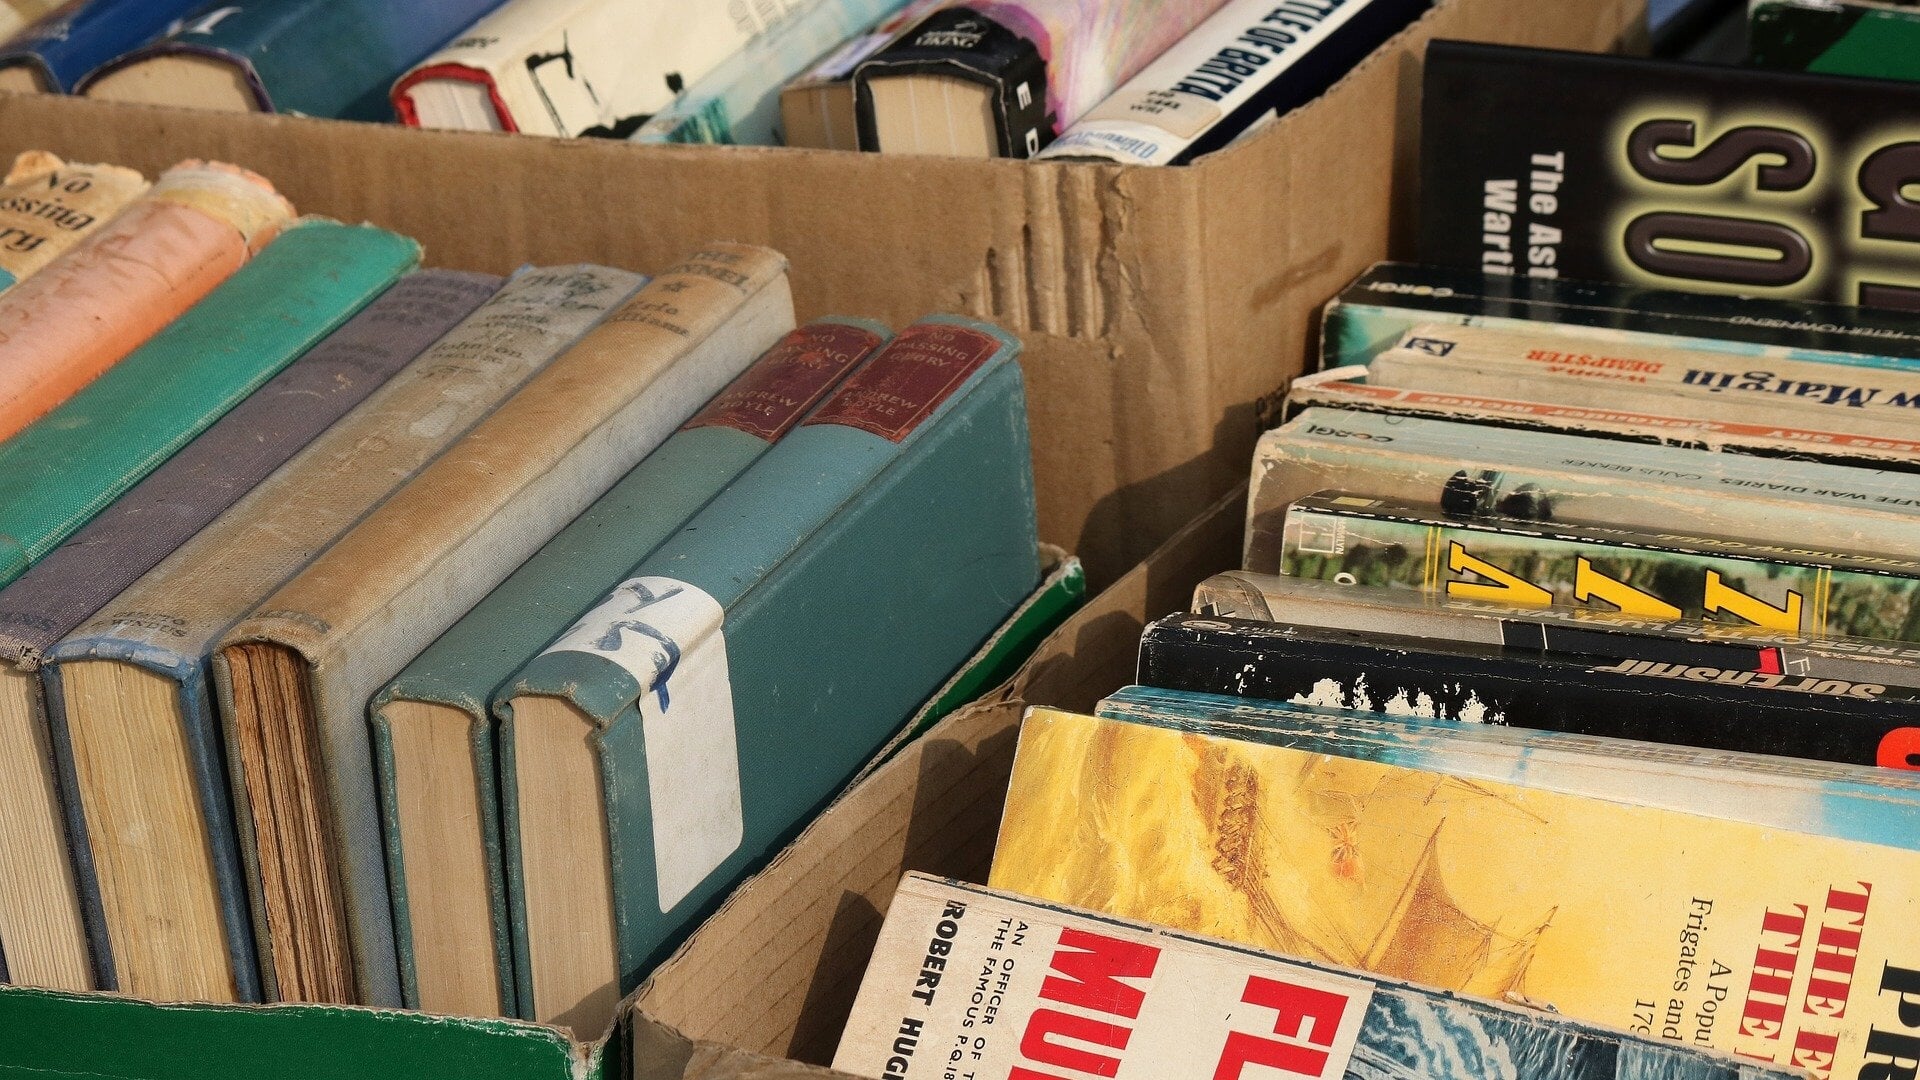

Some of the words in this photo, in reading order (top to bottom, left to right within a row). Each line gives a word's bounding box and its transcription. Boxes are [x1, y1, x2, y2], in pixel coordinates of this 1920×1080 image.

[1236, 27, 1297, 54] OF
[1530, 151, 1564, 215] The
[1624, 118, 1818, 287] SO
[1367, 280, 1454, 298] CORGI
[1526, 350, 1665, 375] DEMPSTER
[1682, 369, 1882, 409] Margin
[1305, 423, 1394, 443] CORGI
[1561, 458, 1633, 474] BEKKER
[1639, 467, 1703, 482] CAJUS
[1718, 477, 1808, 495] DIARIES
[1813, 489, 1867, 502] WAR
[1746, 634, 1806, 647] OF
[1806, 639, 1898, 657] RISE
[990, 917, 1013, 950] THE
[1011, 920, 1029, 946] AN
[1673, 896, 1714, 992] Frigates
[911, 900, 968, 1007] ROBERT
[1803, 881, 1872, 1019] THE
[1711, 958, 1733, 978] A
[1738, 903, 1808, 1040] THE
[961, 957, 997, 1028] FAMOUS
[981, 958, 1014, 1025] OFFICER
[1007, 926, 1162, 1080] MU
[1661, 998, 1684, 1041] and
[970, 1037, 986, 1060] OF
